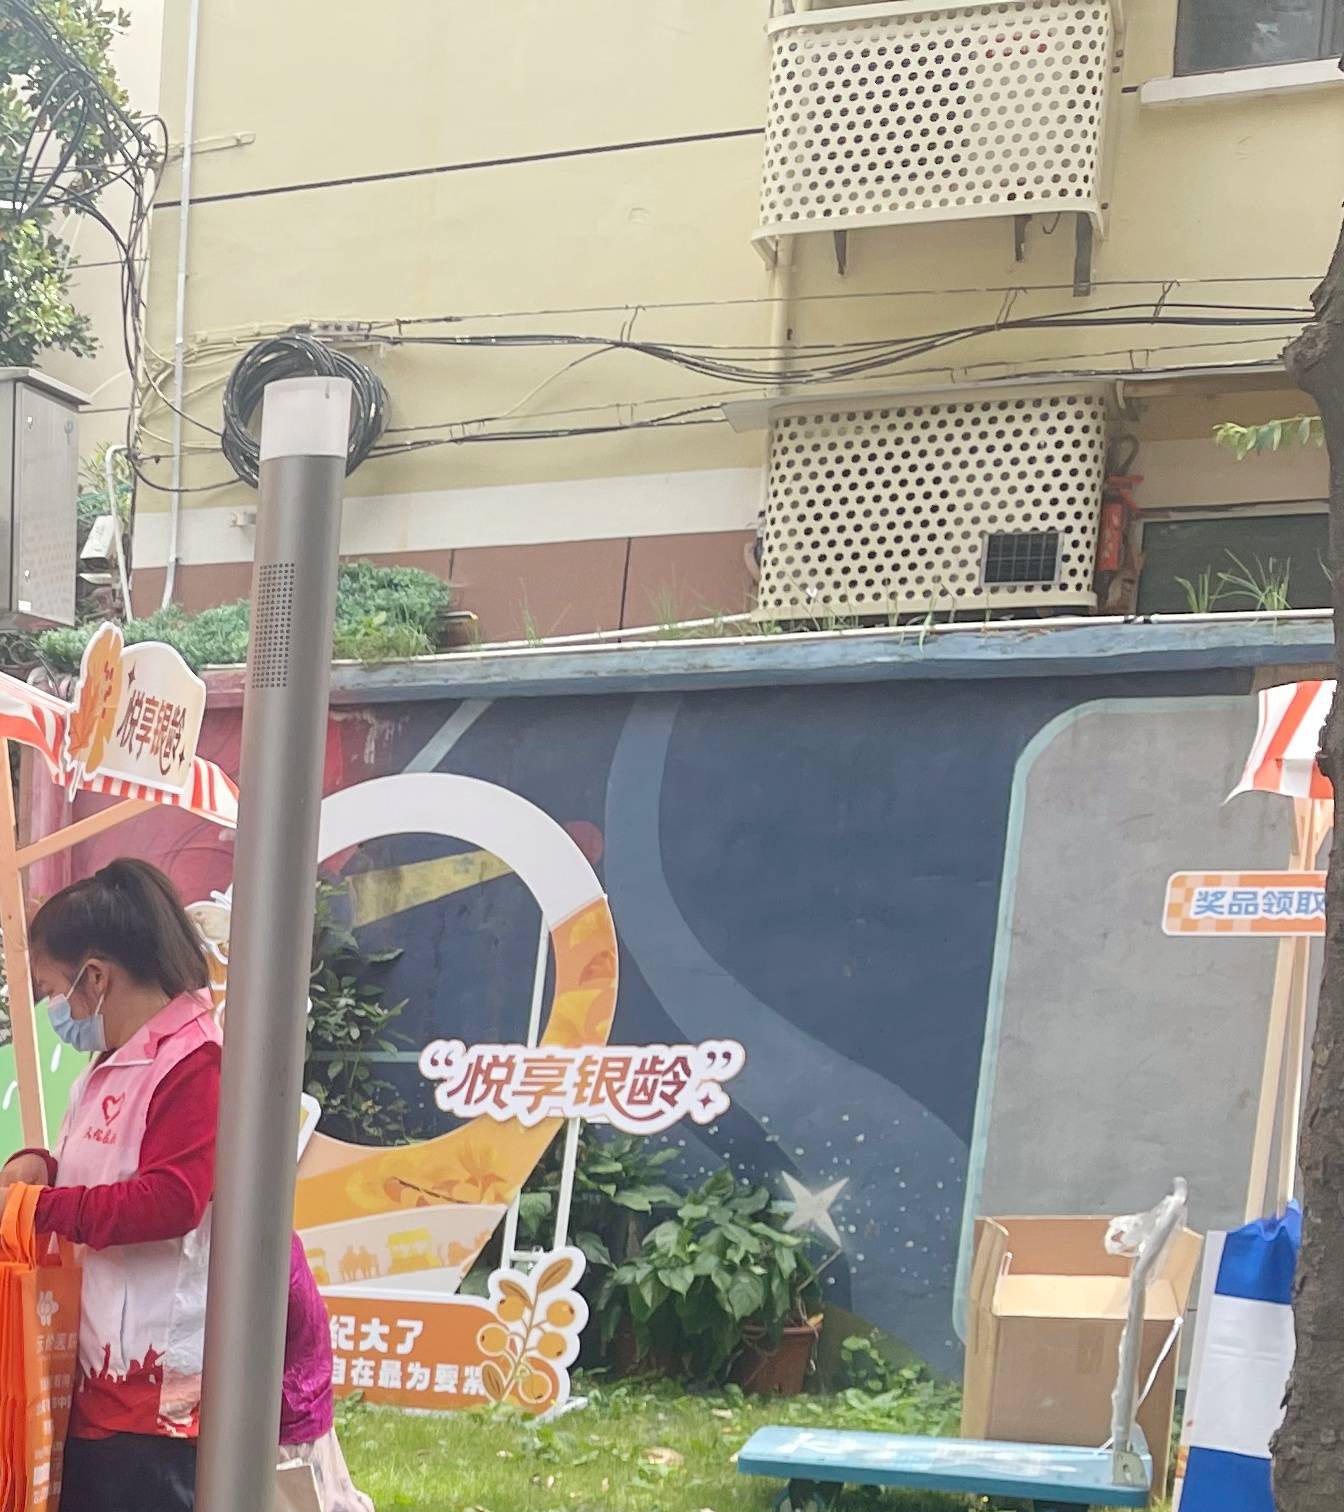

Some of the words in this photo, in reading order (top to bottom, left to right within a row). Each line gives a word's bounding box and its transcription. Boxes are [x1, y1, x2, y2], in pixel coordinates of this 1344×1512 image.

[116, 689, 186, 775] 悦享银龄
[1193, 890, 1326, 915] 奖品领取
[329, 1315, 423, 1355] 纪大了
